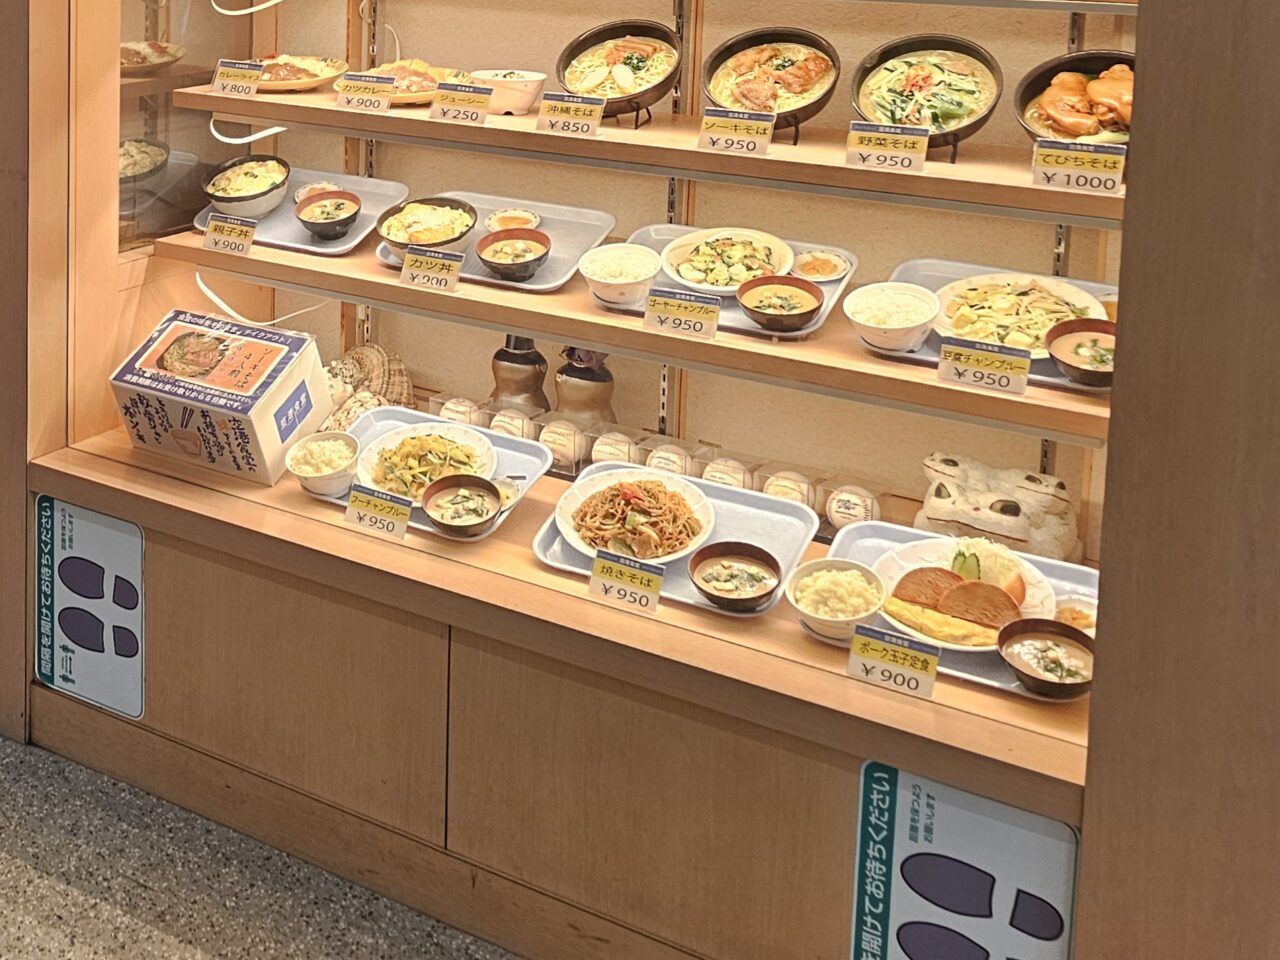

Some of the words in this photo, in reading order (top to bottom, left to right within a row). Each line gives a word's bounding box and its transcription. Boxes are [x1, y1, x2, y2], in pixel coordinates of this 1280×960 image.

[221, 83, 251, 95] ¥800
[342, 84, 391, 95] カツカレー
[345, 97, 380, 109] ¥900
[440, 94, 484, 105] ジューシー
[440, 108, 479, 121] ¥250
[547, 104, 594, 117] 沖縄そば
[548, 120, 590, 134] ¥850
[704, 121, 768, 136] ソーキそば
[708, 137, 756, 152] ¥950
[857, 135, 919, 150] 野菜そば
[858, 152, 912, 169] ¥950
[1038, 153, 1120, 170] てびちそば
[1042, 171, 1116, 191] ¥1000
[212, 239, 245, 252] ¥900
[409, 257, 454, 274] カツ丼
[409, 272, 448, 288] ¥900
[657, 315, 703, 332] ¥950
[954, 367, 1010, 388] ¥950
[357, 511, 395, 533] ¥950
[600, 564, 654, 588] 焼きそば
[40, 502, 52, 676] 間隔を開けてお待ちください
[602, 582, 649, 607] ¥950
[858, 641, 930, 672] ポーク玉子定食
[860, 662, 920, 690] ¥900
